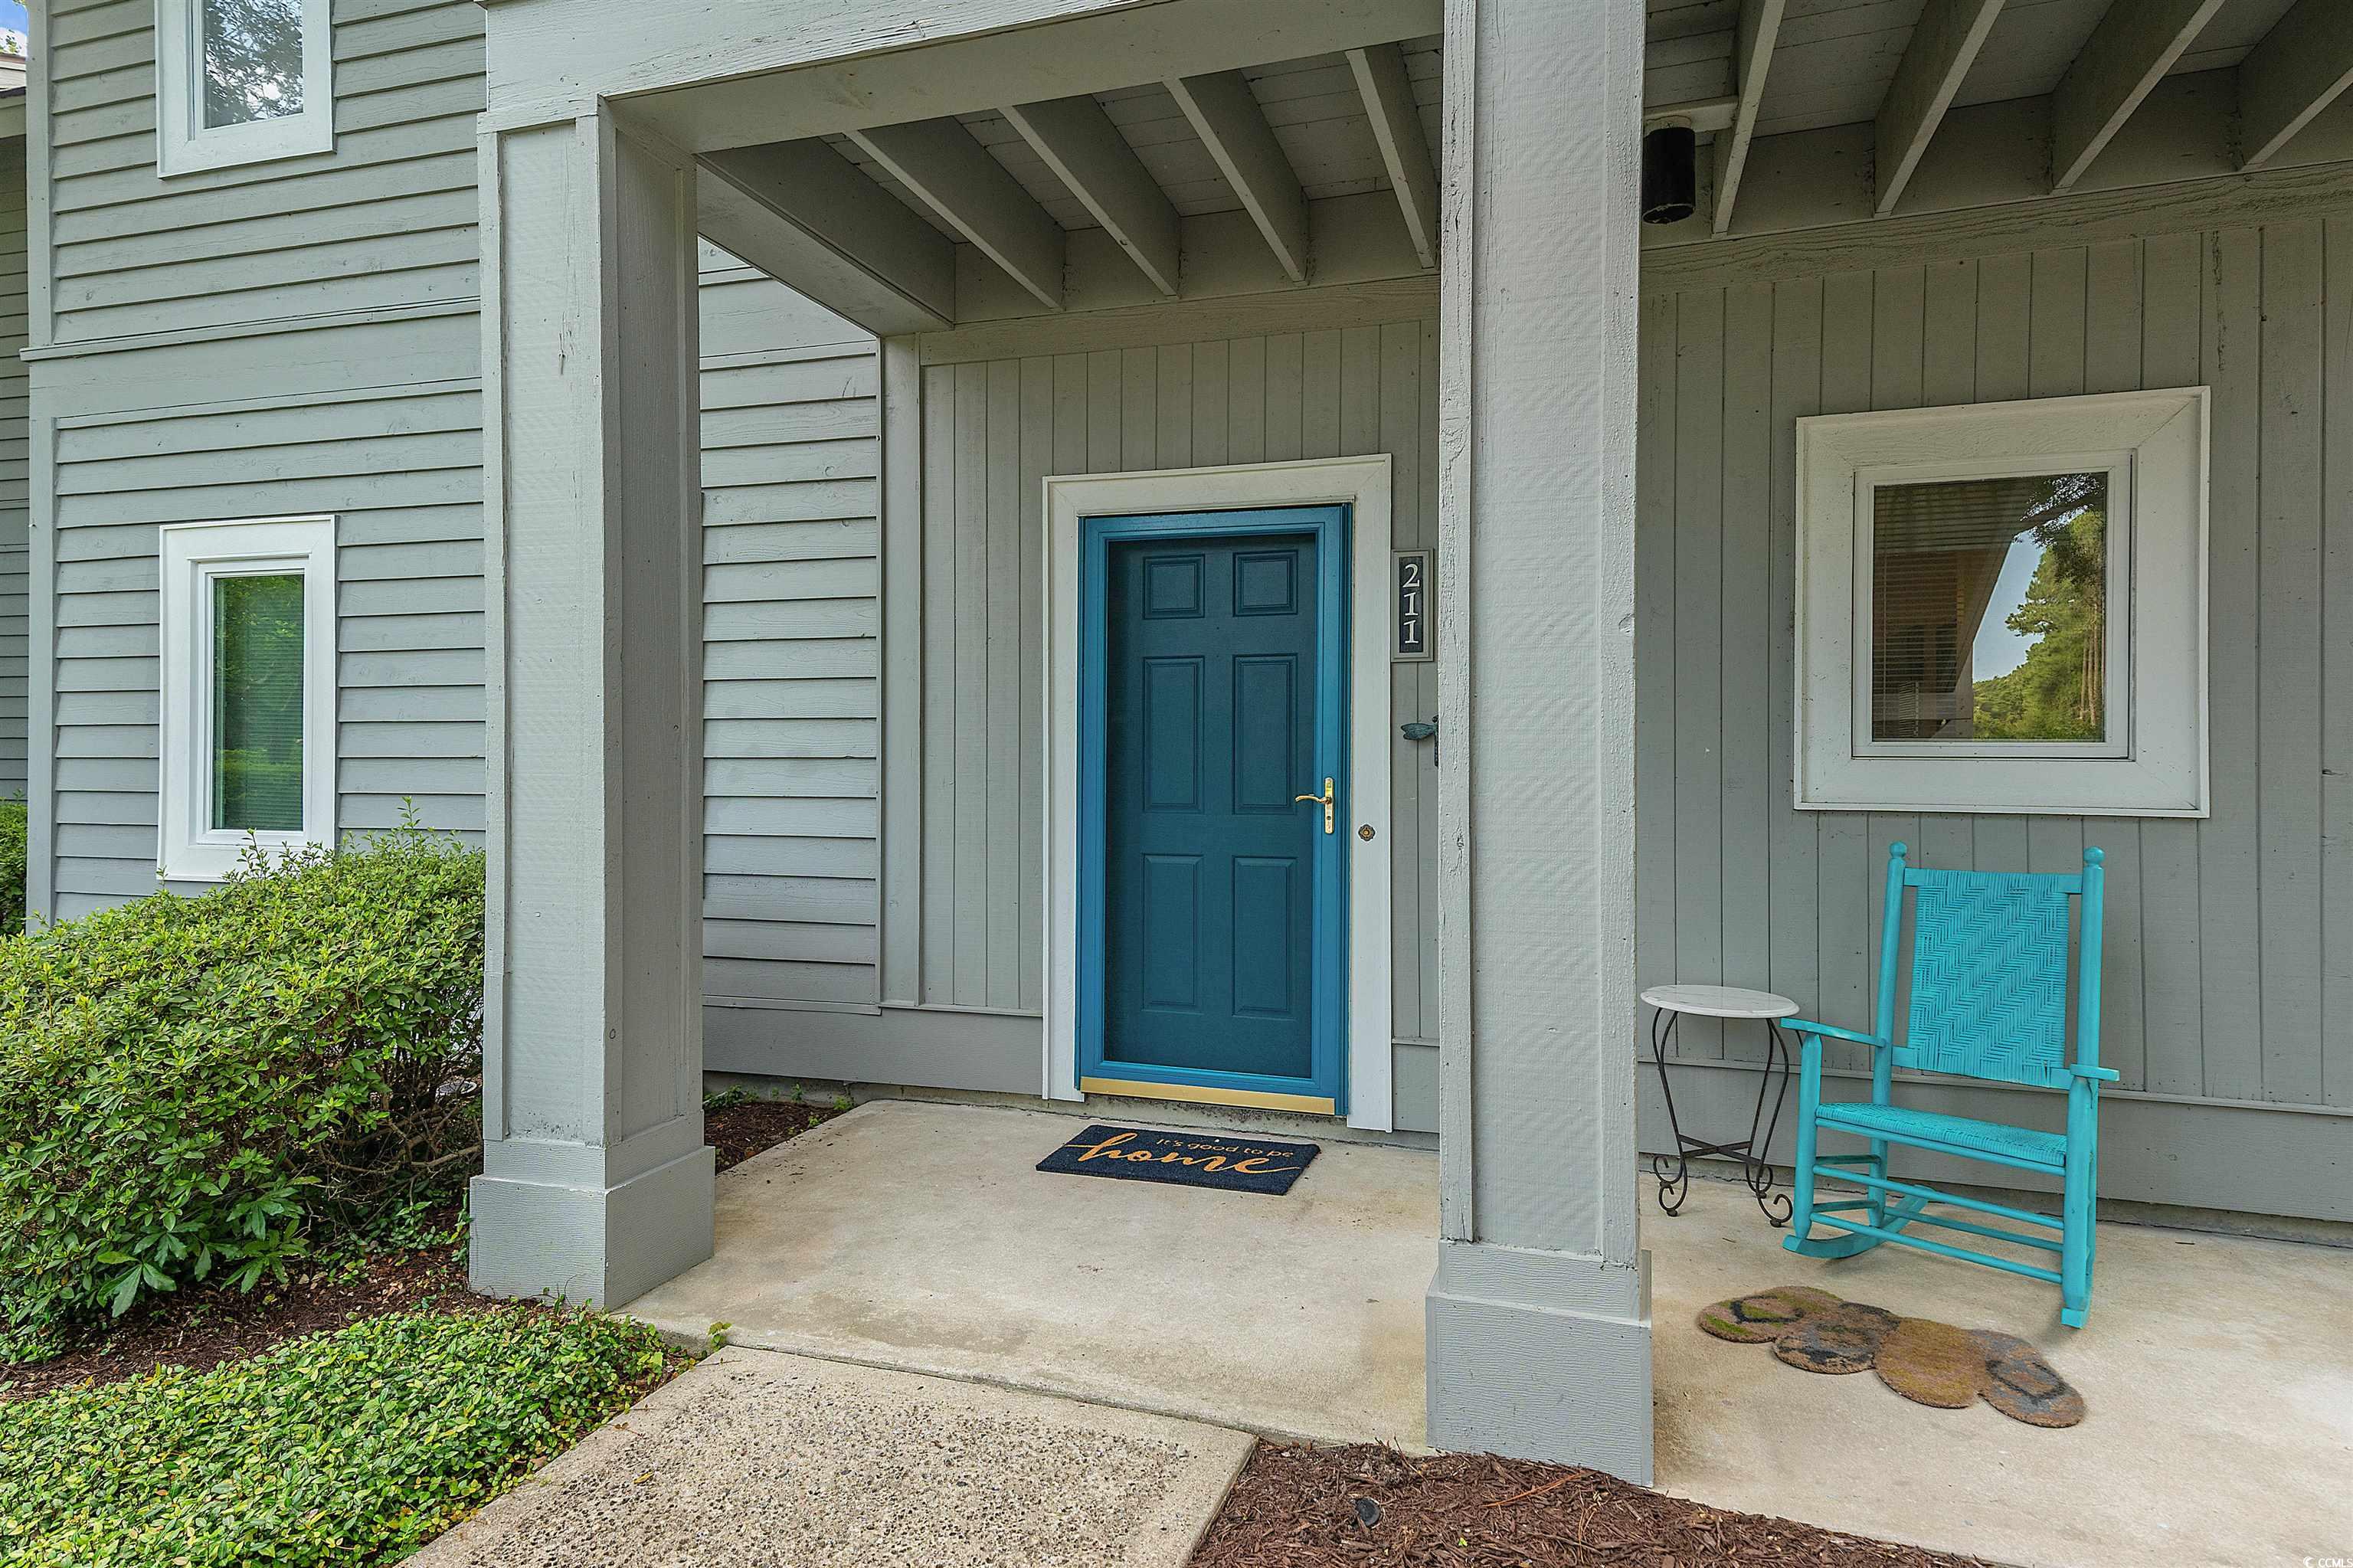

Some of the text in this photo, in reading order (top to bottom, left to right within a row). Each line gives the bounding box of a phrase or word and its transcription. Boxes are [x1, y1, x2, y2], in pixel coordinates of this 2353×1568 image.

[1402, 563, 1420, 644] 211
[1065, 1132, 1301, 1174] home
[1187, 1142, 1239, 1153] good
[1243, 1147, 1263, 1155] to
[1266, 1150, 1294, 1158] be
